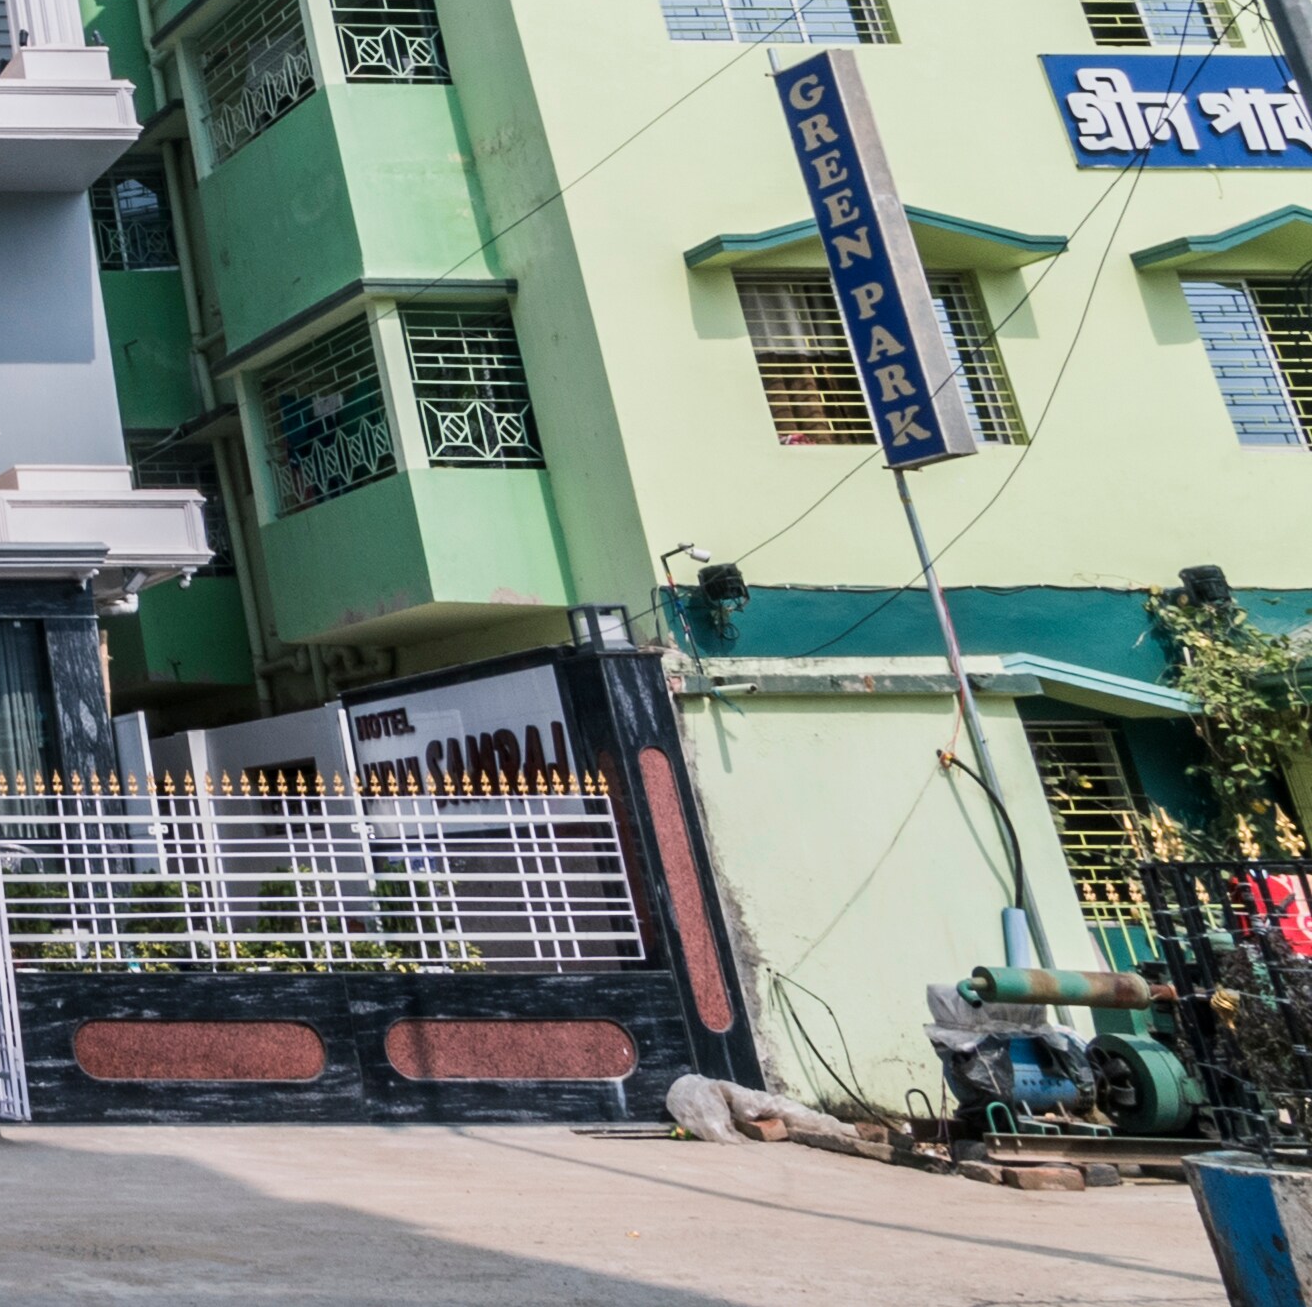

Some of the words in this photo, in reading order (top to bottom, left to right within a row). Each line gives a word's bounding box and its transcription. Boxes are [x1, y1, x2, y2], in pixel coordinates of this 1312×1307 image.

[789, 73, 873, 269] GREEN
[850, 282, 932, 446] PARK
[354, 707, 416, 742] HOTEL
